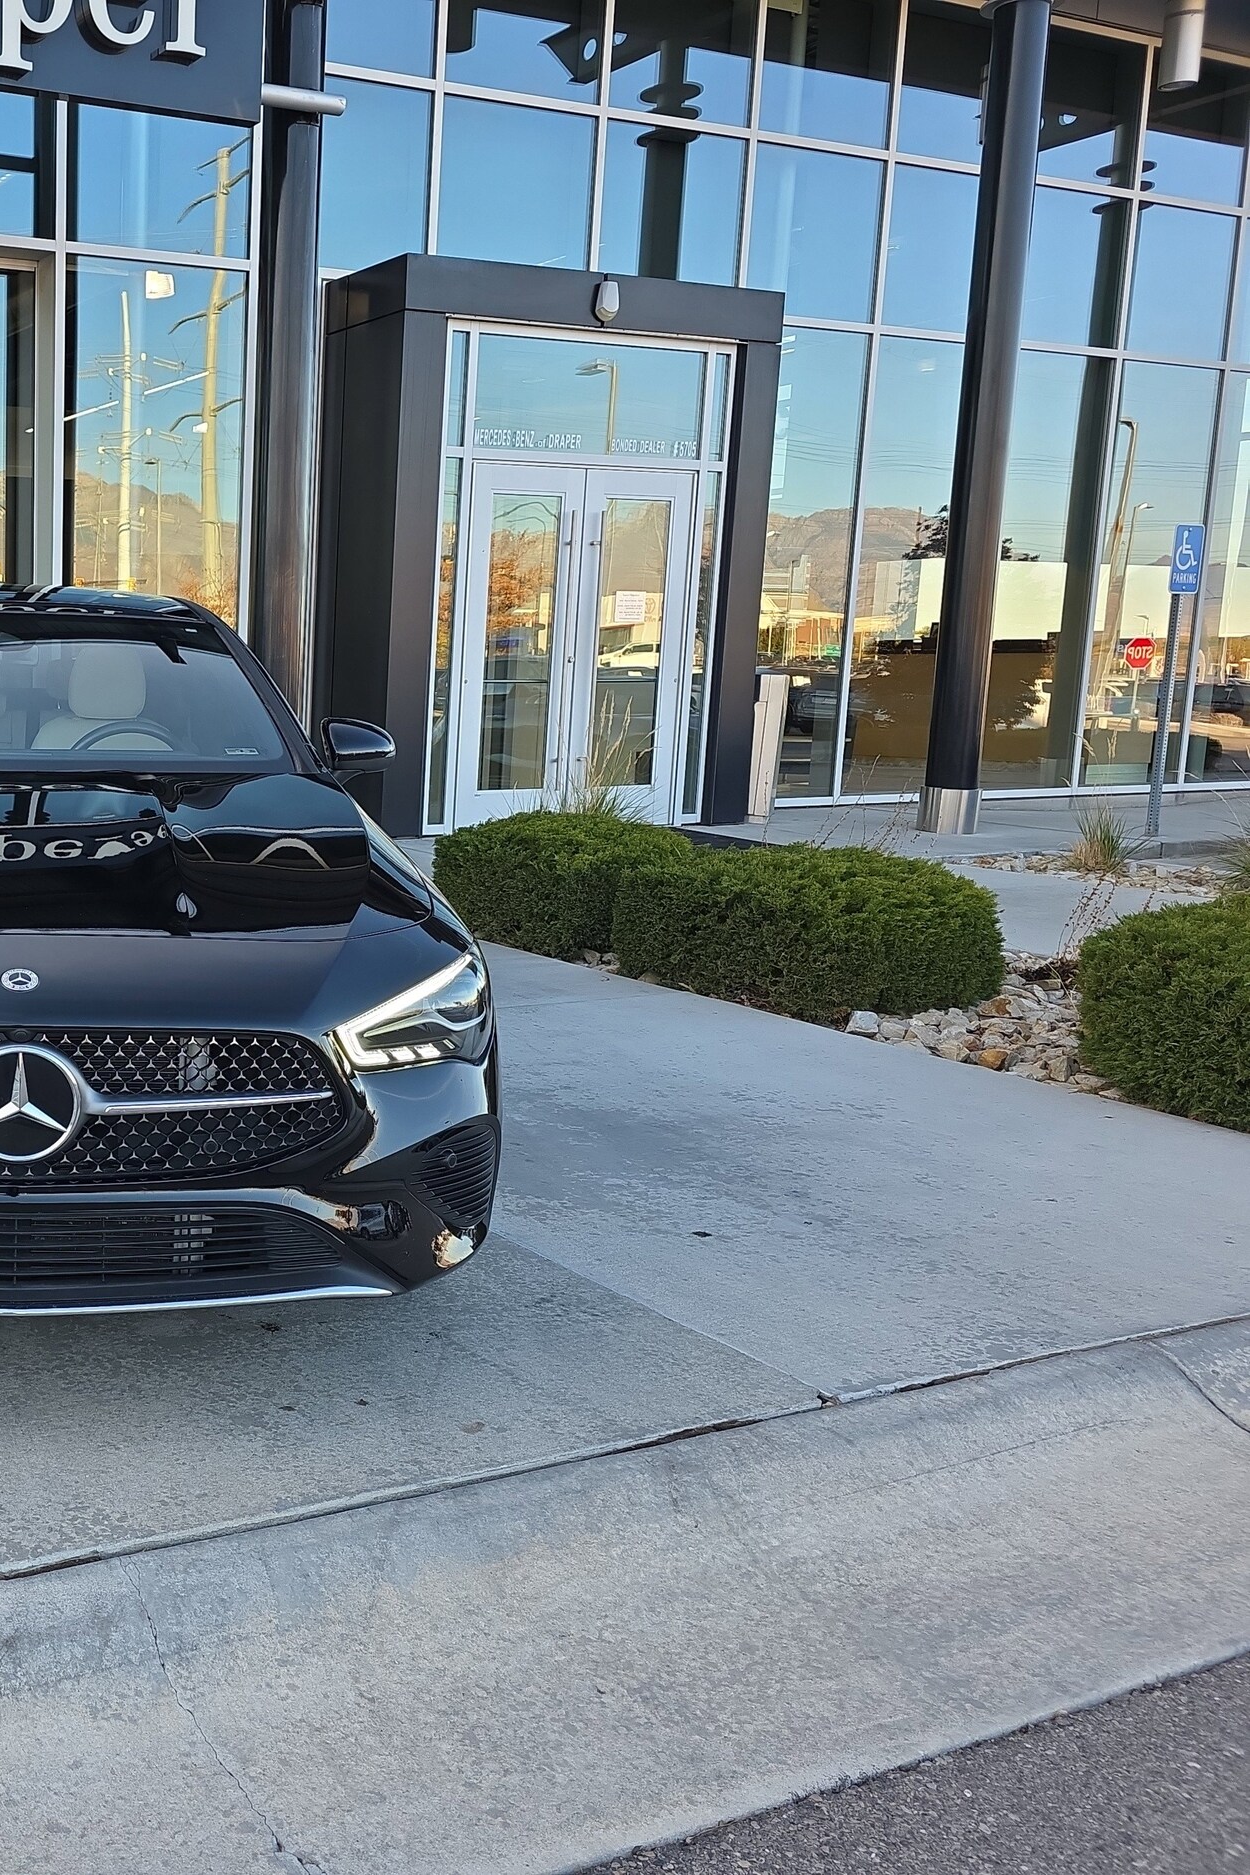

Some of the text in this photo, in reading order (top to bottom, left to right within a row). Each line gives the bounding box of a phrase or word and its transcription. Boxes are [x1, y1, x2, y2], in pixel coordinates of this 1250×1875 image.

[548, 433, 582, 449] DRAPER
[612, 439, 637, 452] BONDED
[640, 440, 665, 454] DEALER
[1172, 572, 1197, 584] PARKING
